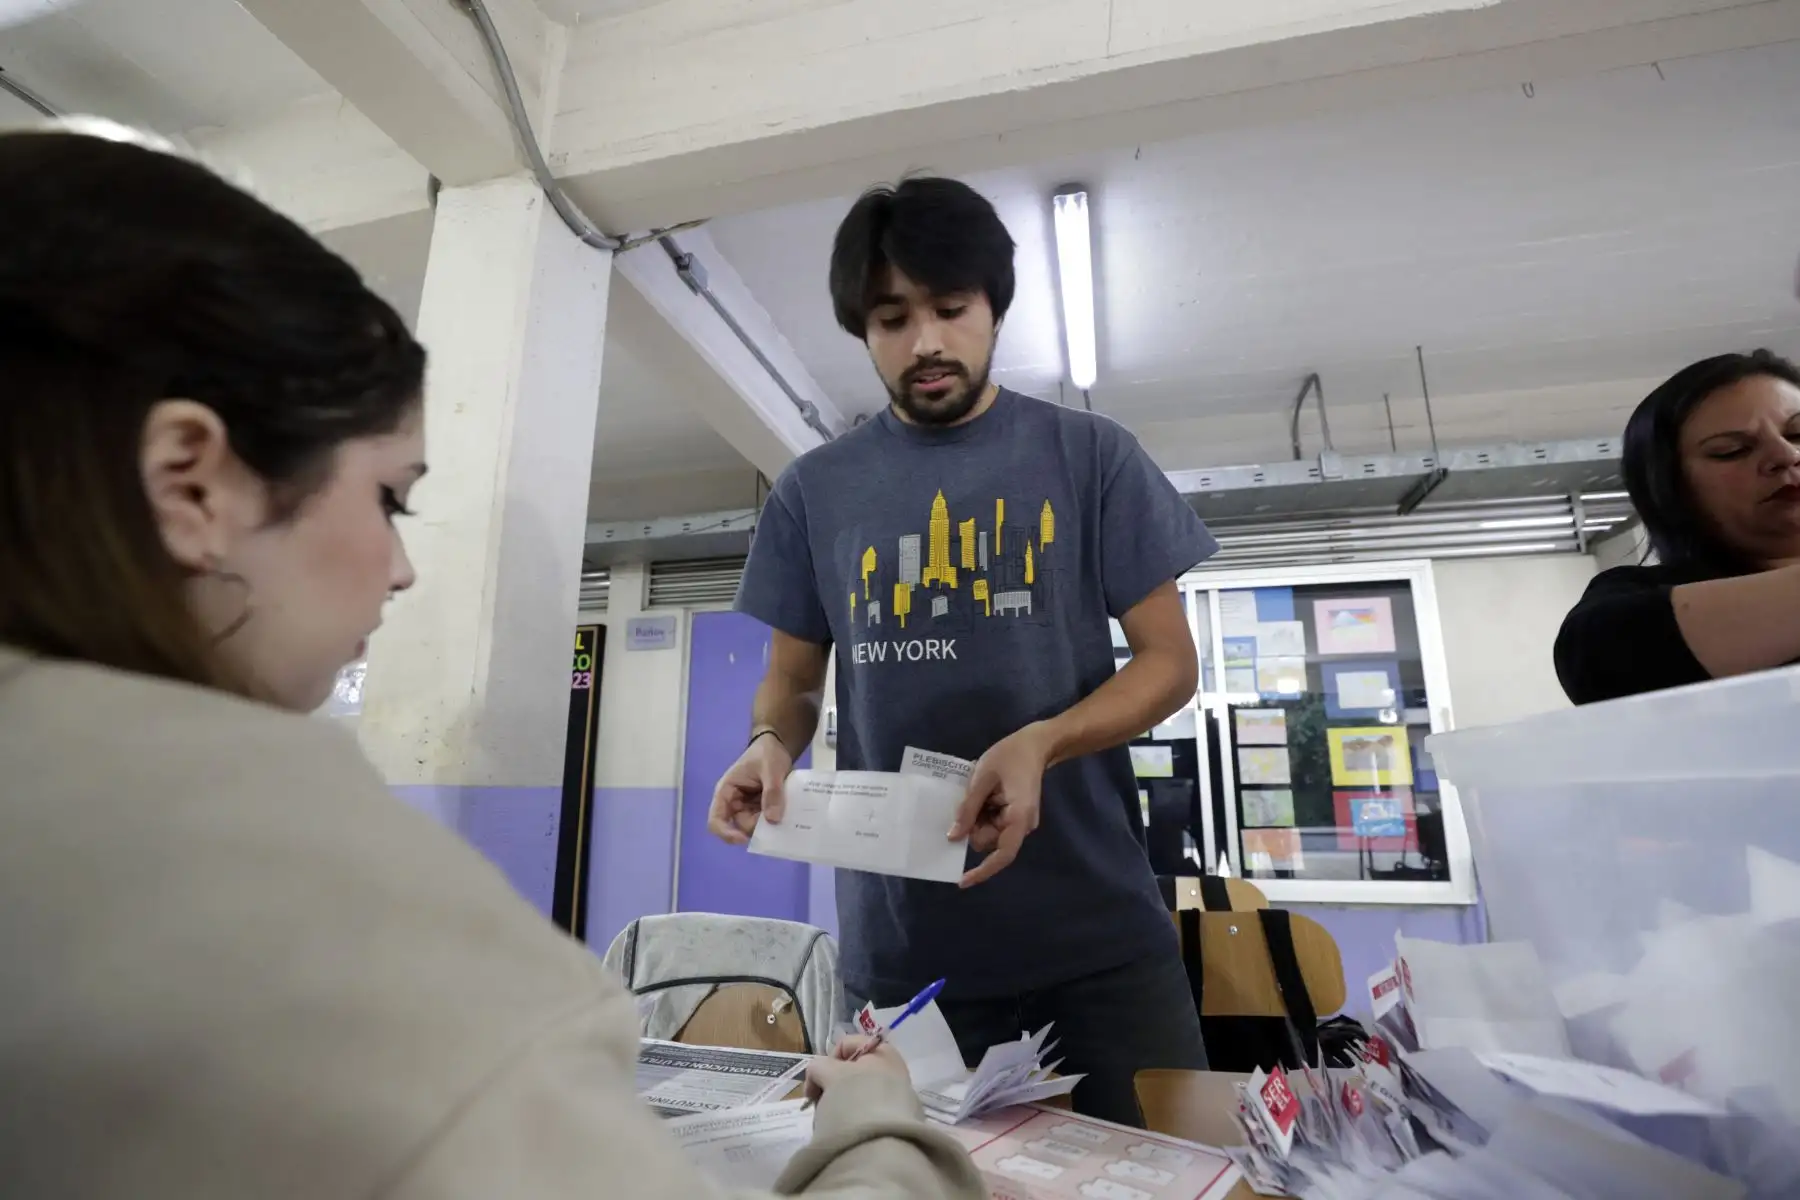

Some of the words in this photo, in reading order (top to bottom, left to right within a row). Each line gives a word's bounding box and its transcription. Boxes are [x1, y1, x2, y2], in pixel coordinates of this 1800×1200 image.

[852, 642, 888, 664] NEW
[892, 639, 958, 662] YORK
[913, 753, 971, 772] PLEBISCITO
[1263, 1077, 1286, 1109] SER
